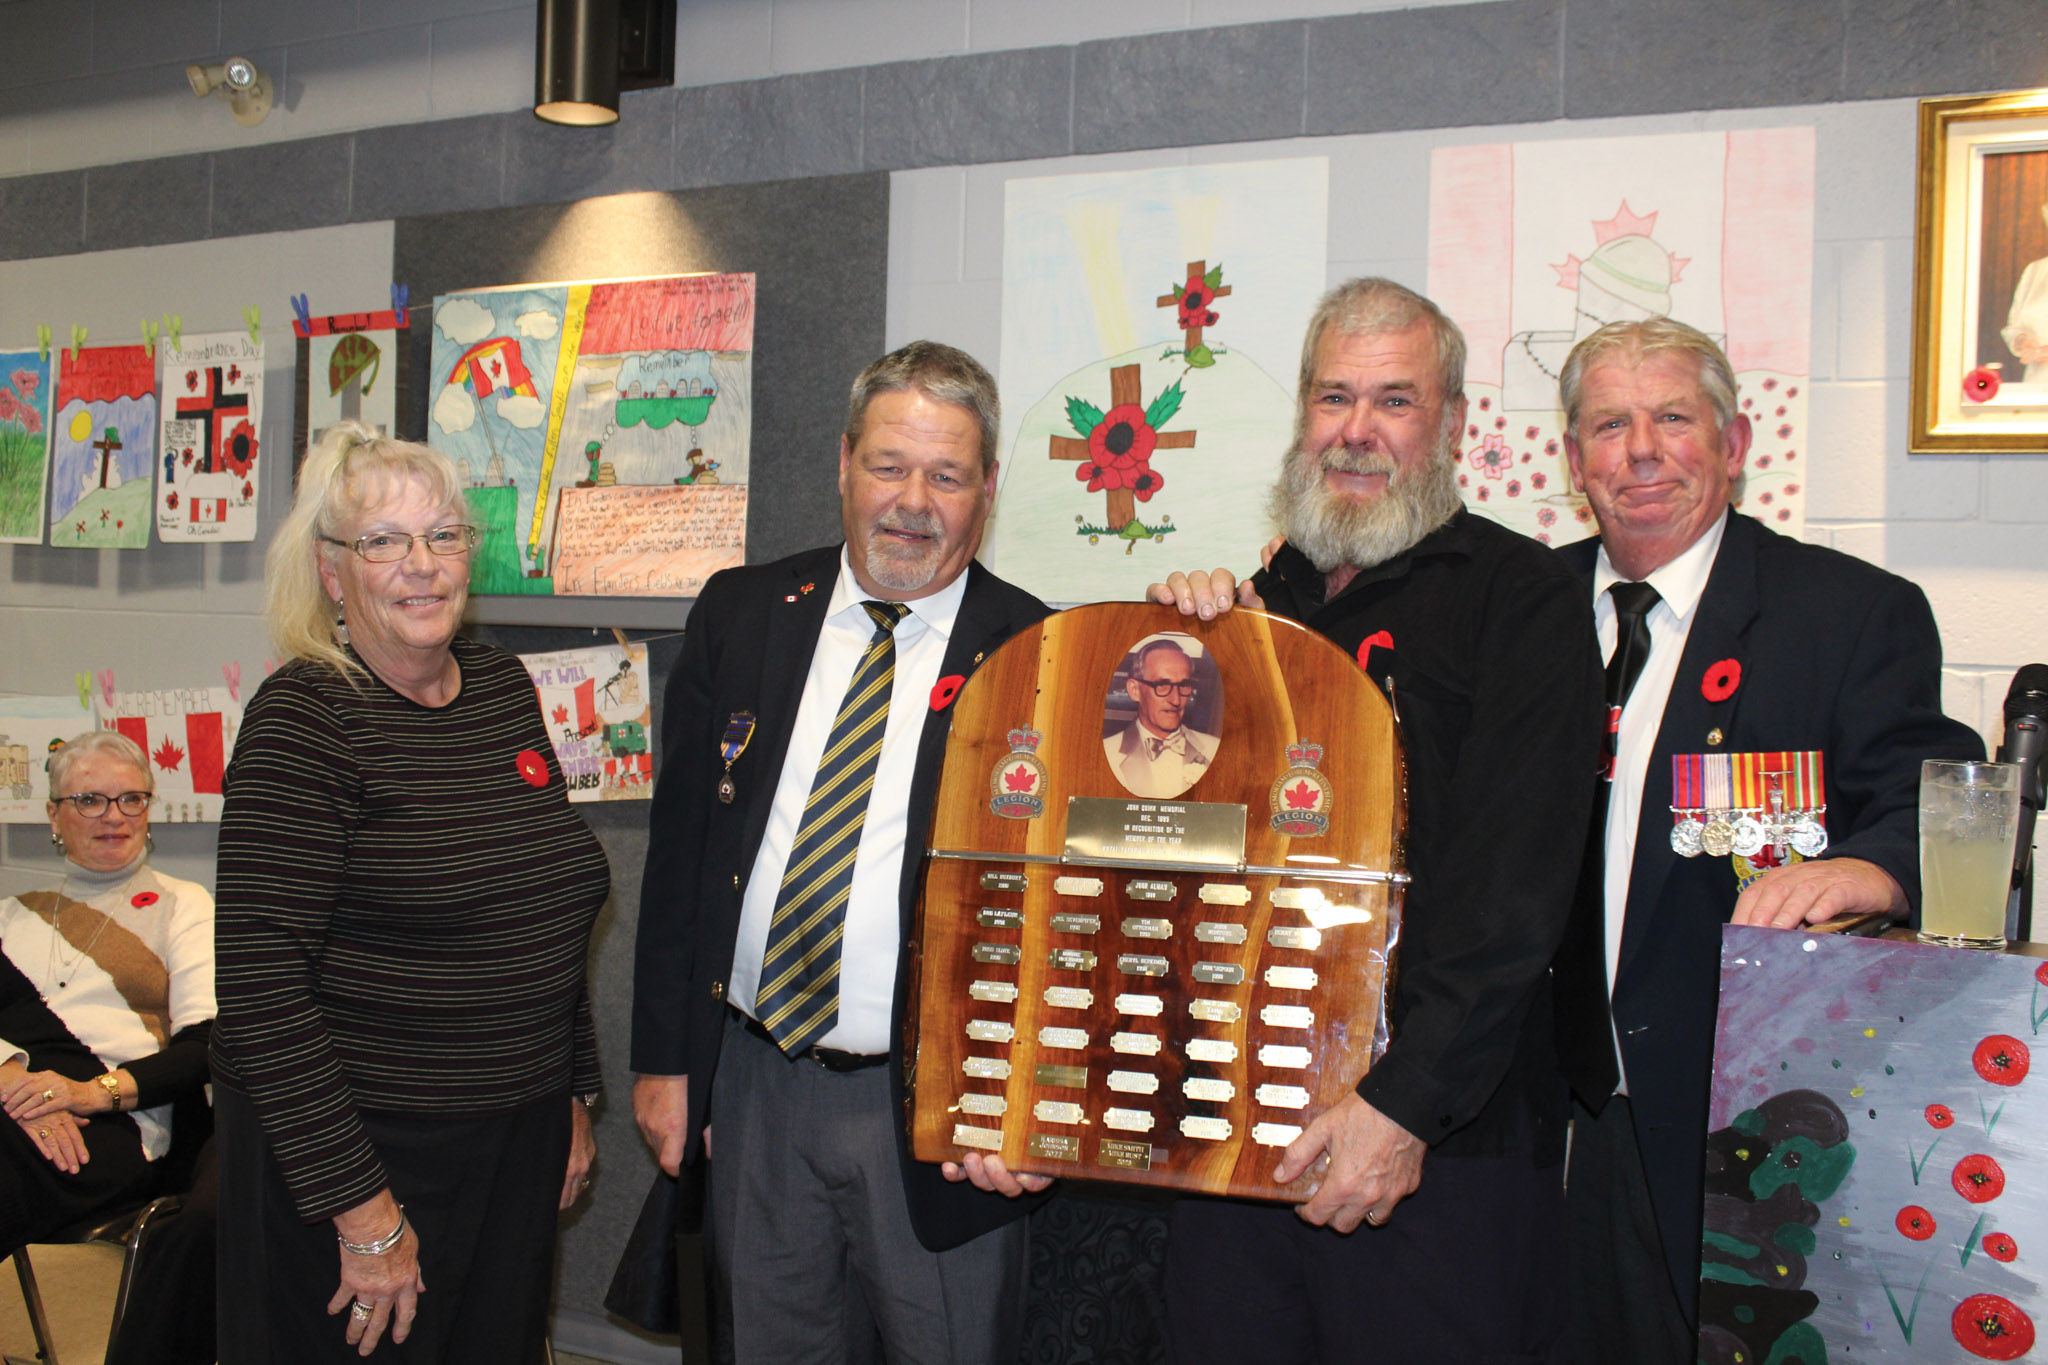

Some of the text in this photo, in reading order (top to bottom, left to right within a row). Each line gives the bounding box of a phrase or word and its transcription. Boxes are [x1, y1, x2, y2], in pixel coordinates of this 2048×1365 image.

[556, 664, 588, 684] WILL
[996, 795, 1039, 806] LEGION
[1160, 806, 1186, 814] MEMORIAL
[1277, 812, 1323, 823] LEGION
[1132, 825, 1164, 833] RECOGNITION
[1166, 826, 1173, 834] OF
